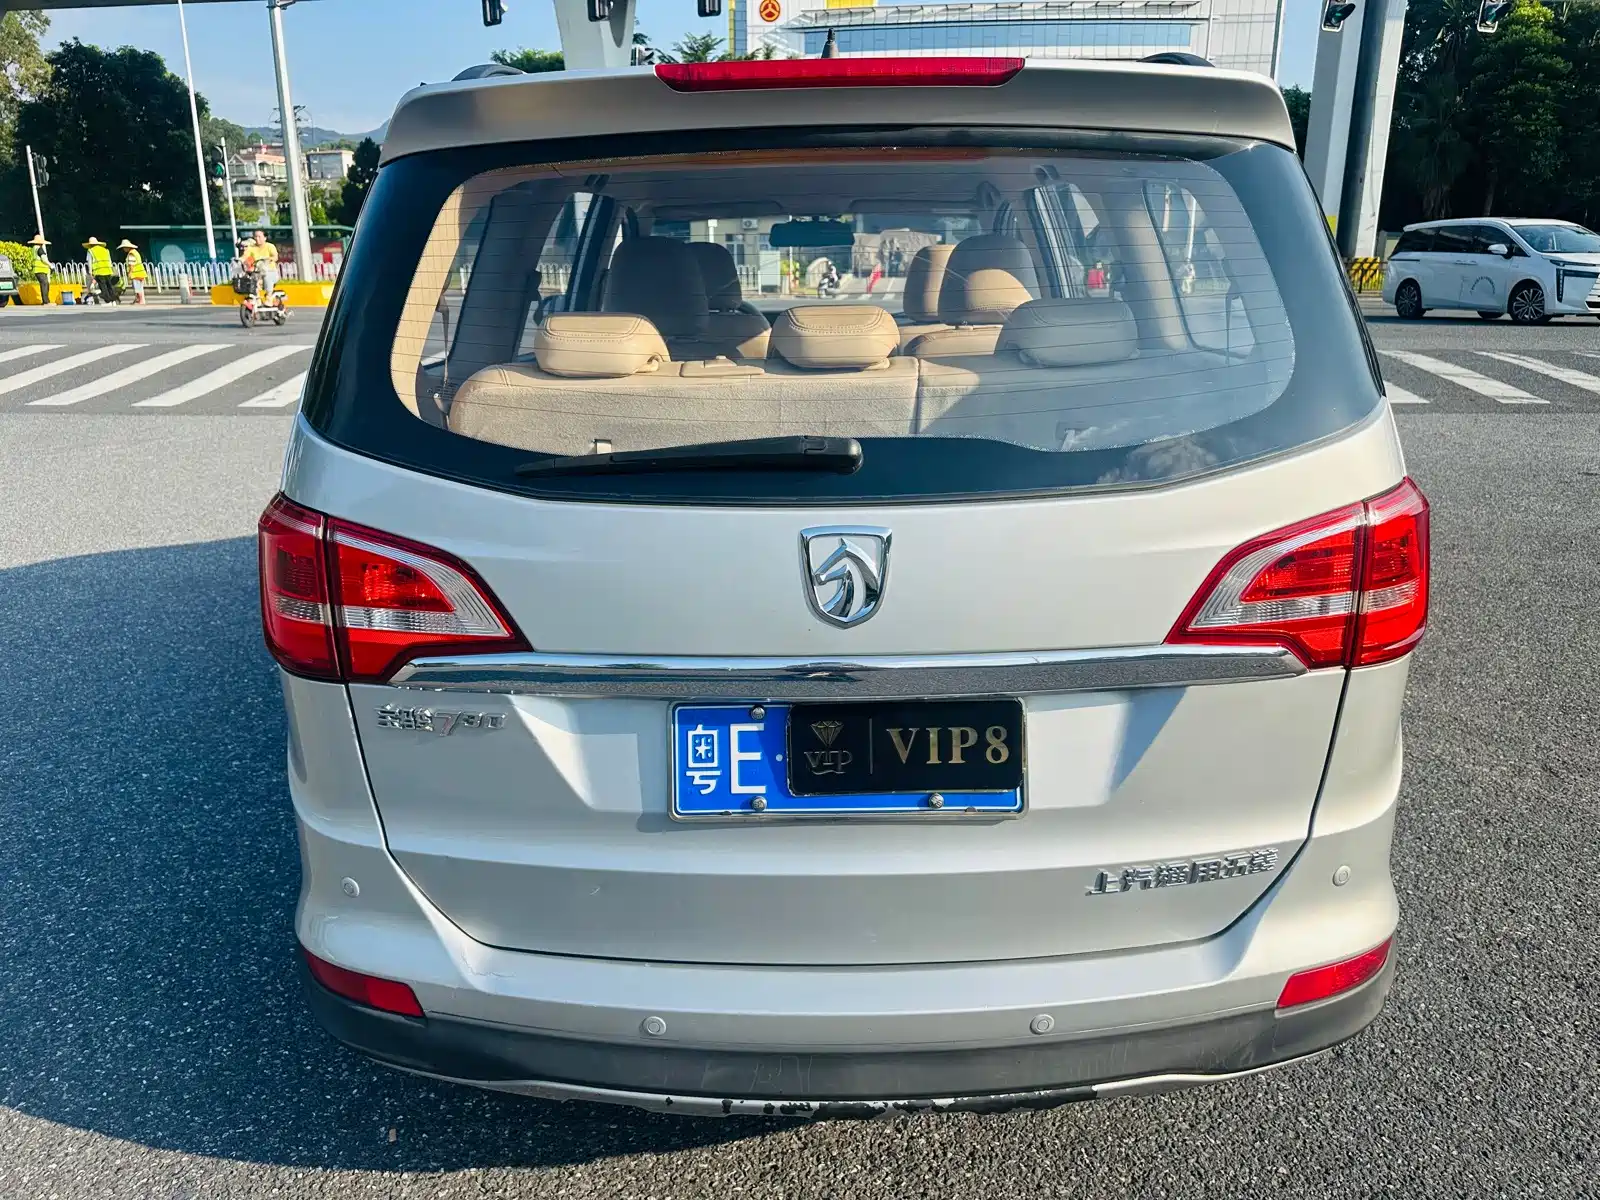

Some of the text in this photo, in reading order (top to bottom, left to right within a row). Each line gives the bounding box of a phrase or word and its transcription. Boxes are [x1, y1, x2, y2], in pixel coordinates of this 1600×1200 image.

[886, 725, 1010, 766] VIP8
[1084, 847, 1279, 897] 上汽通用五菱
